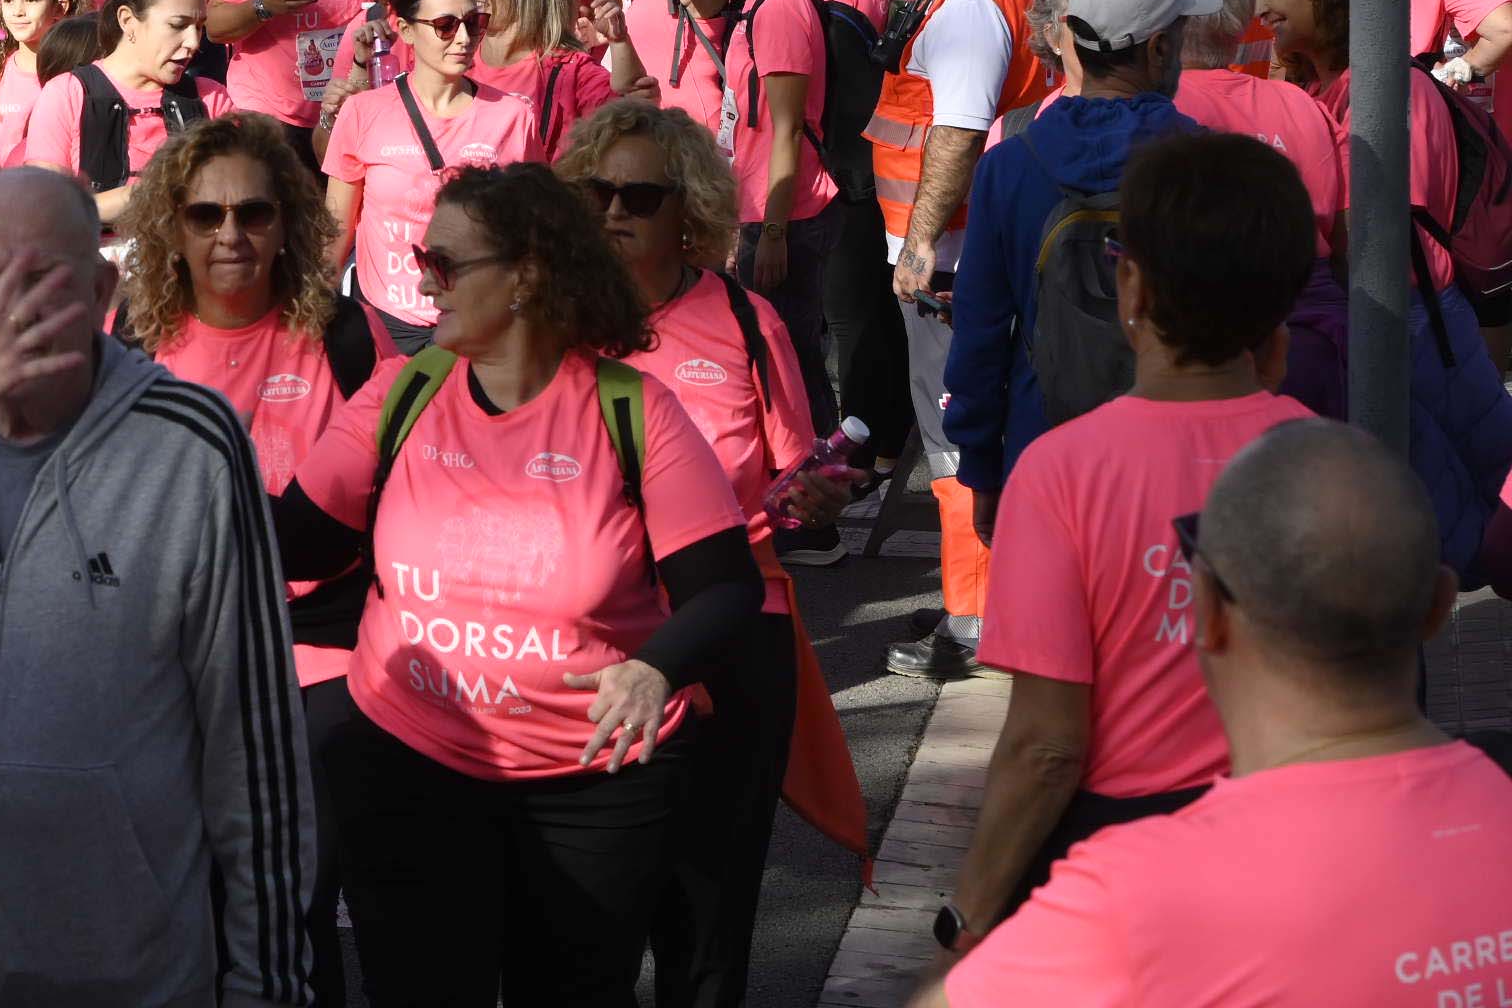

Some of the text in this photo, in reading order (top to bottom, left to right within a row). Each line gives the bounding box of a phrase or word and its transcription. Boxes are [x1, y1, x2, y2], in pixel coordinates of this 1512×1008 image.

[295, 10, 319, 28] TU
[392, 561, 439, 600] TU
[400, 611, 568, 661] DORSAL
[409, 658, 519, 705] SUMA
